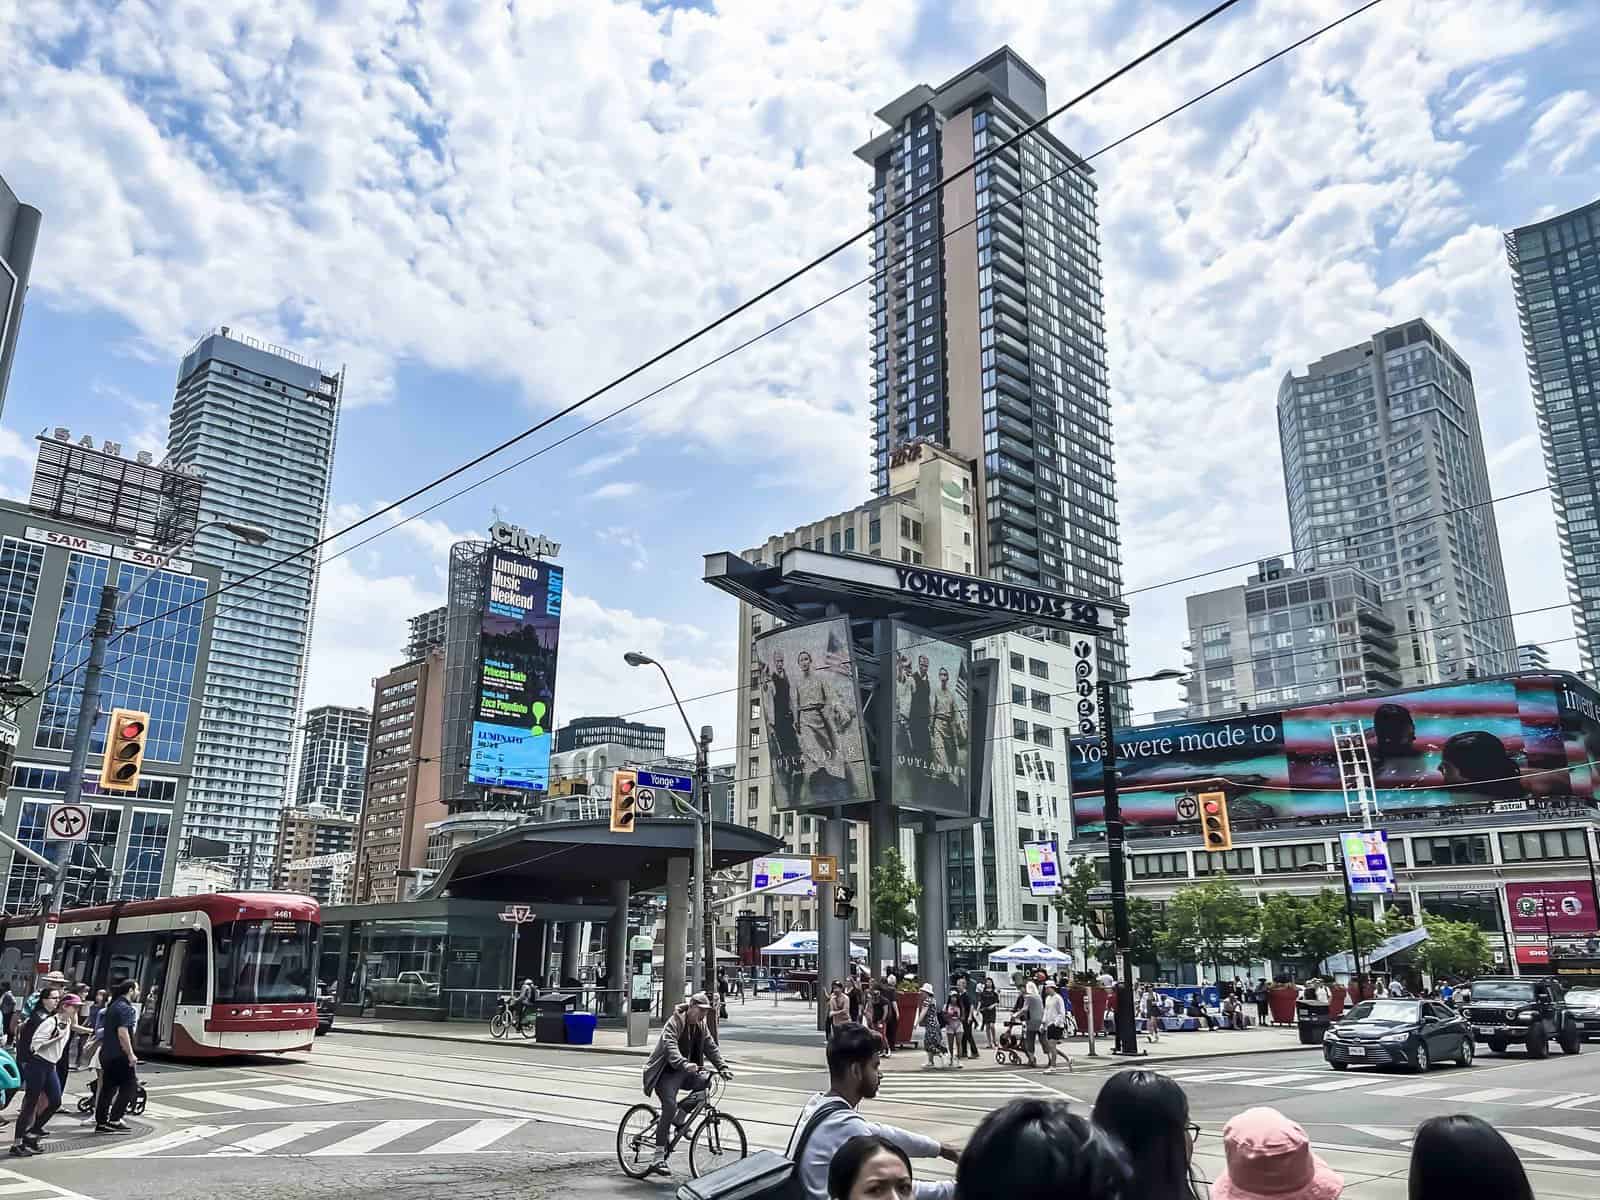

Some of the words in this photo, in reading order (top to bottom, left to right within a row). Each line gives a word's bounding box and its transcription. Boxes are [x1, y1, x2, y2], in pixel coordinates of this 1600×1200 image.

[47, 532, 88, 549] SAM
[493, 554, 538, 581] Luminato
[491, 571, 521, 592] Music
[490, 586, 534, 611] Weekend
[896, 568, 1066, 618] YONGE-DUNDAS
[1071, 600, 1100, 625] SQ
[1076, 743, 1112, 764] Yo
[1120, 736, 1172, 759] were
[1179, 724, 1245, 752] made
[1252, 722, 1276, 743] to
[651, 774, 674, 788] Yonge
[1500, 800, 1523, 811] astral
